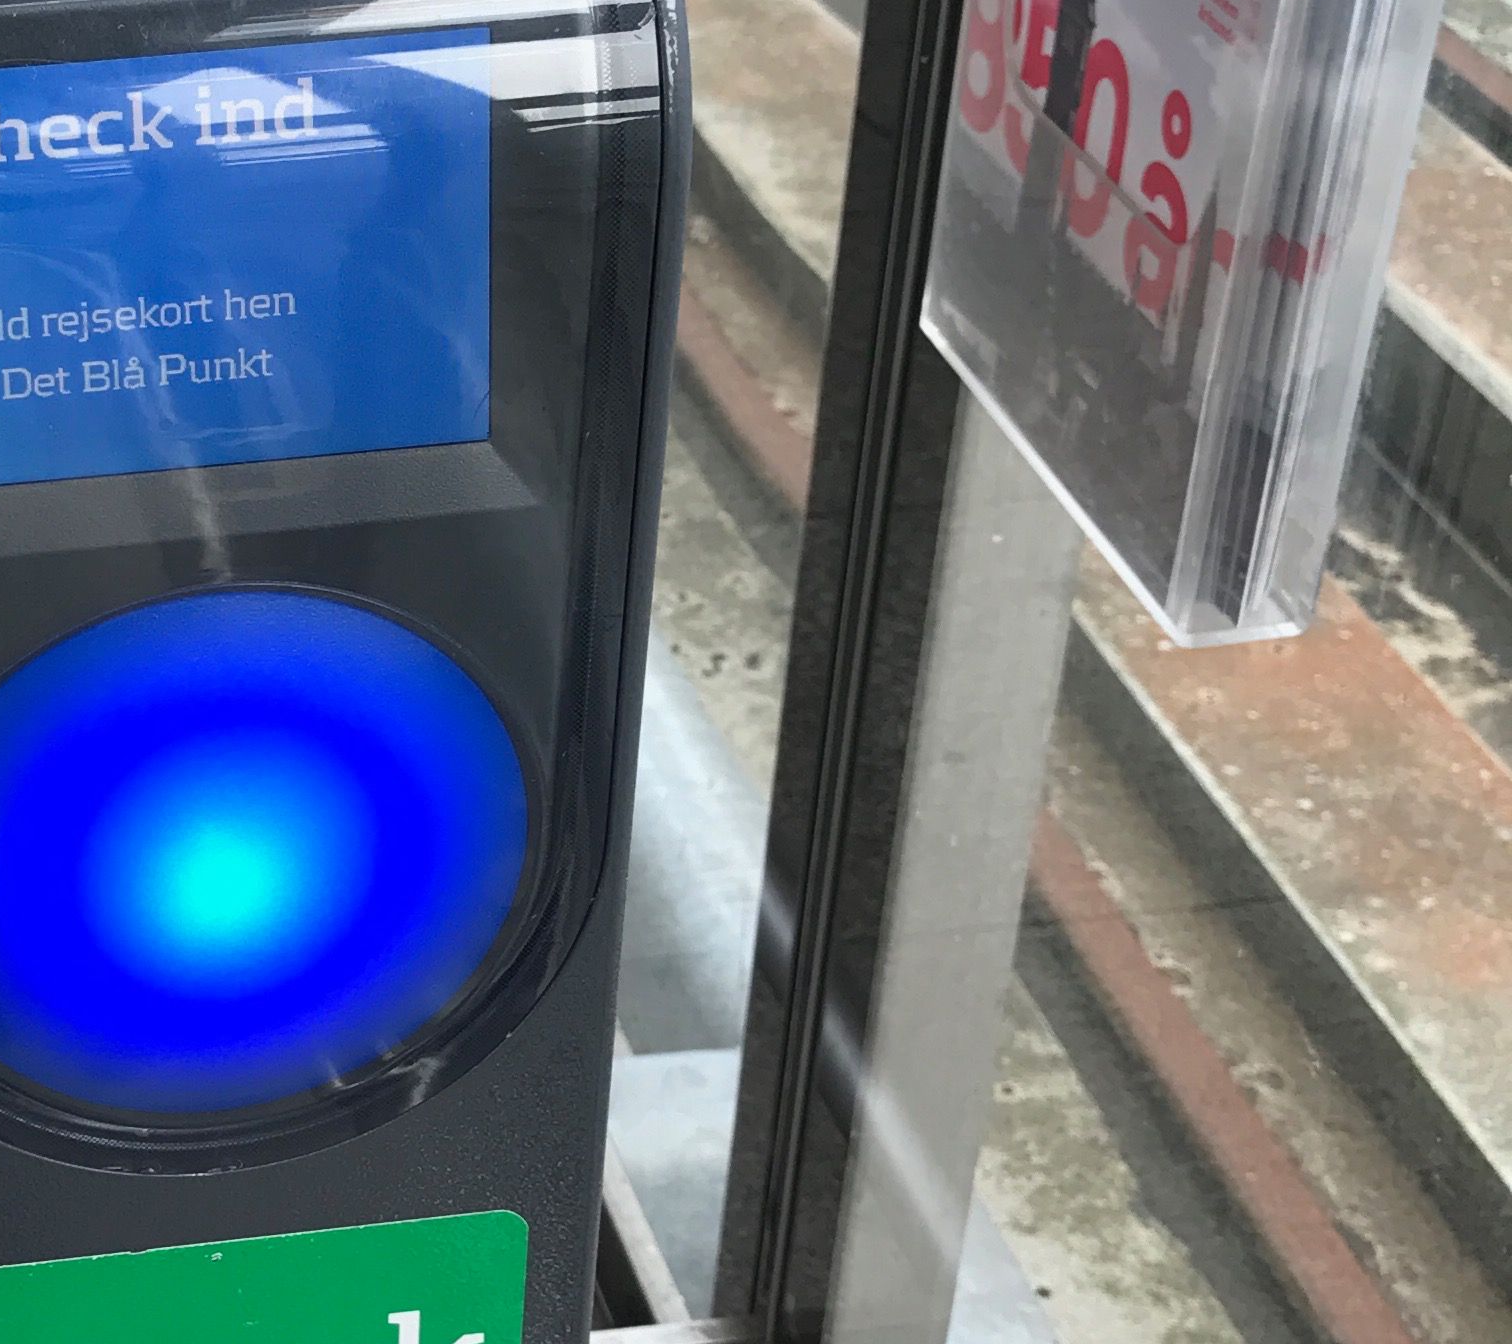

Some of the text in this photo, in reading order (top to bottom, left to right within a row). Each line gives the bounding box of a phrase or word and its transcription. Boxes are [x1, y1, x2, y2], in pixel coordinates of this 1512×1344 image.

[194, 76, 317, 146] ind
[41, 294, 213, 342] rejsekort
[223, 288, 297, 321] hen
[2, 367, 71, 400] Det
[82, 356, 145, 393] Blå
[158, 348, 274, 386] Punkt
